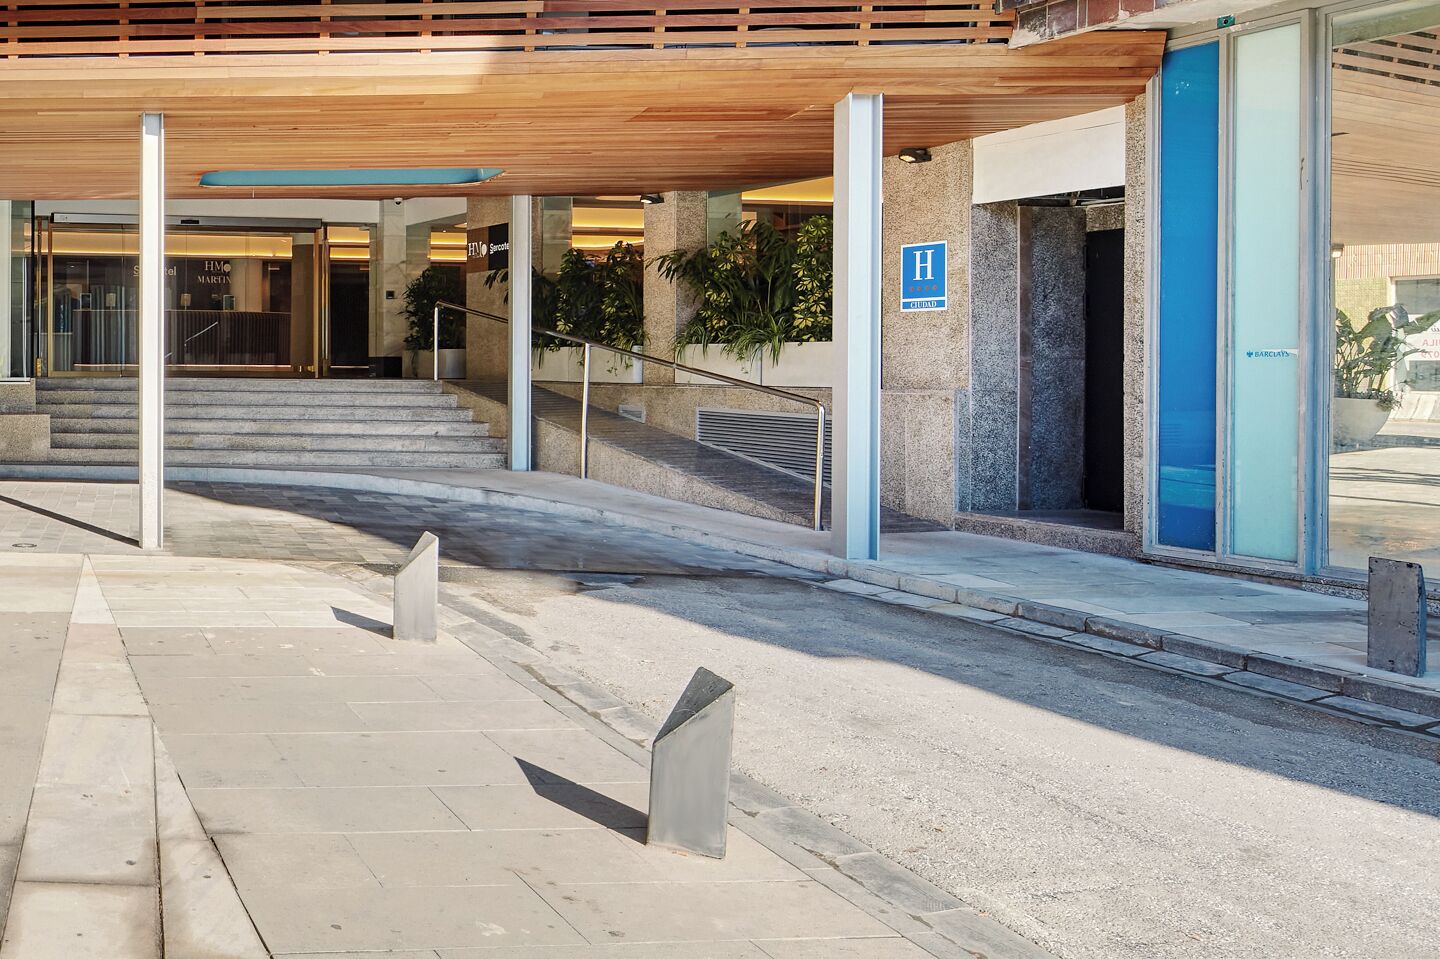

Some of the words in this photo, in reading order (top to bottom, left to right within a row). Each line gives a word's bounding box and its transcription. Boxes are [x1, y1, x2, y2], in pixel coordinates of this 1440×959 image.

[490, 242, 509, 254] Sercote
[913, 249, 935, 281] H
[197, 275, 232, 284] MARTIN
[910, 300, 937, 309] CIUDAD
